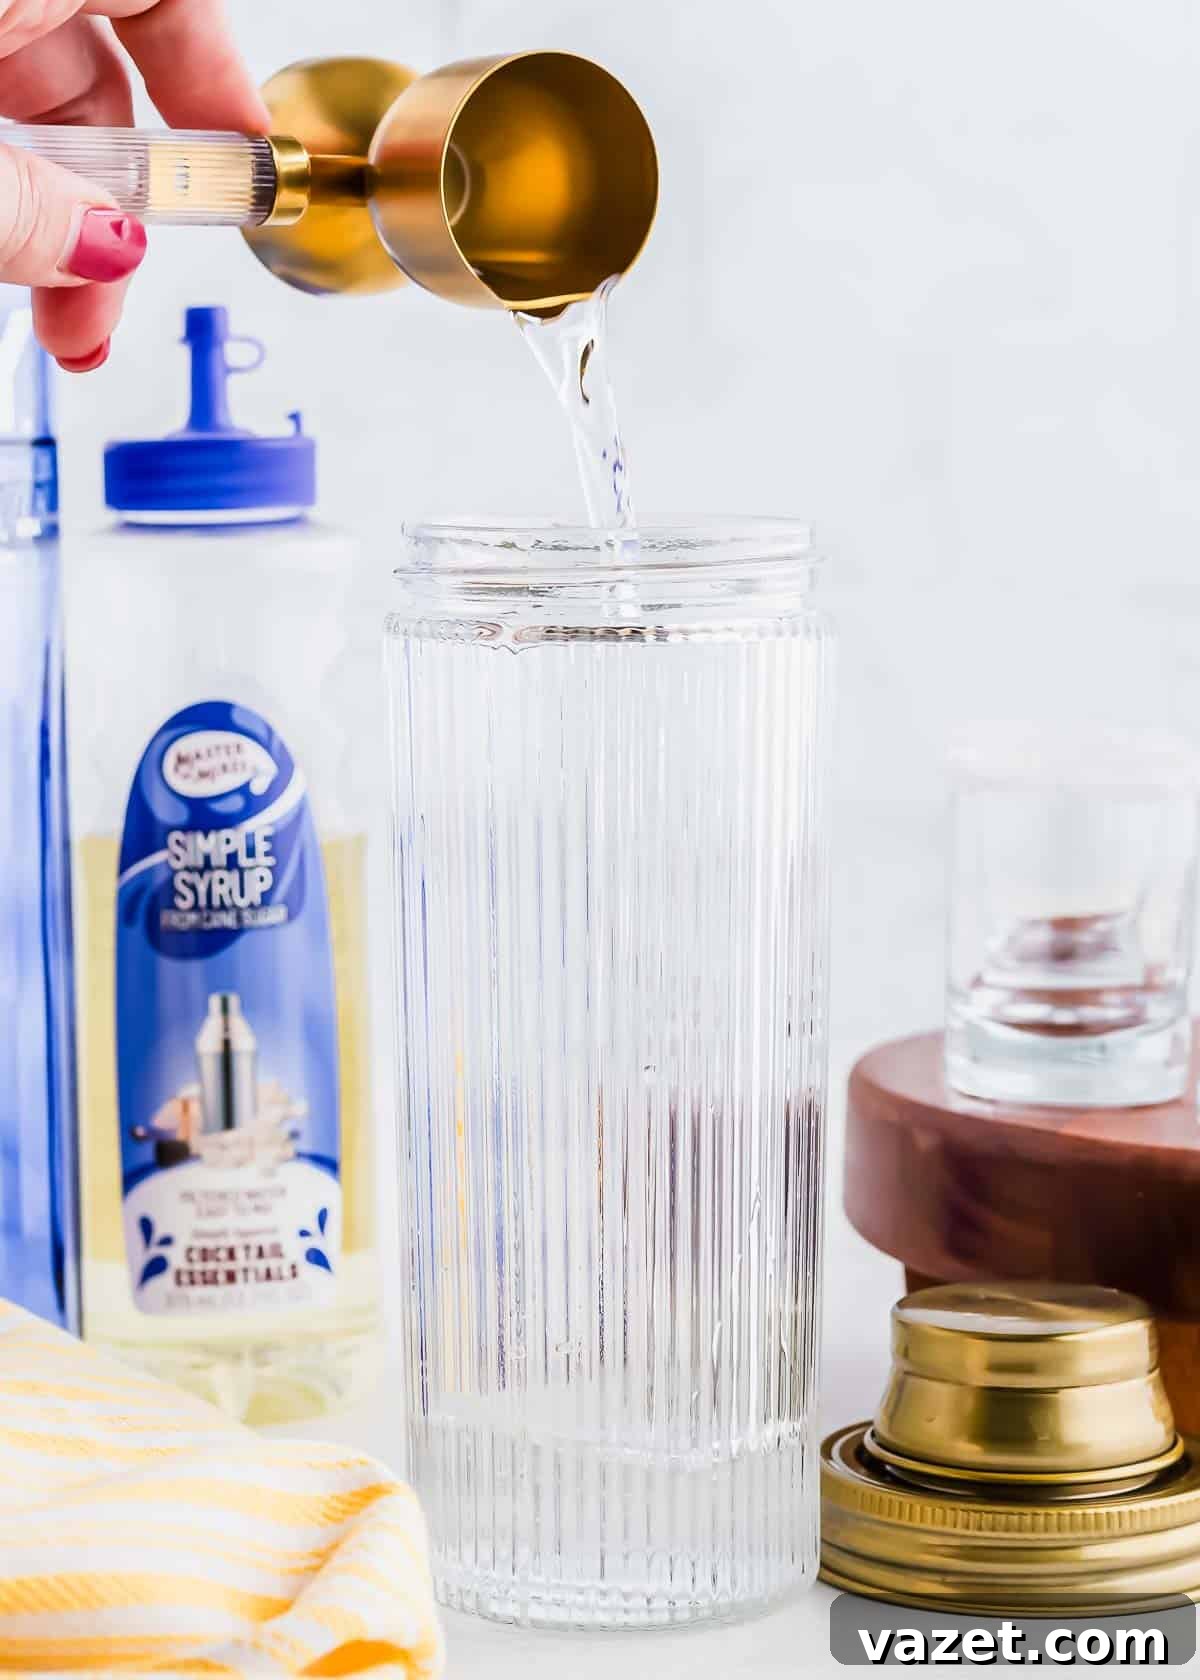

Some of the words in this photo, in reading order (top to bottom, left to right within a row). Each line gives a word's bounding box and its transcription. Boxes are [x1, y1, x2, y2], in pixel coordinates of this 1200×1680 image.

[166, 825, 277, 869] SIMPLE
[173, 868, 274, 911] SYRUP
[184, 1243, 285, 1264] COCKTAIL
[174, 1263, 299, 1287] ESSENTIALS
